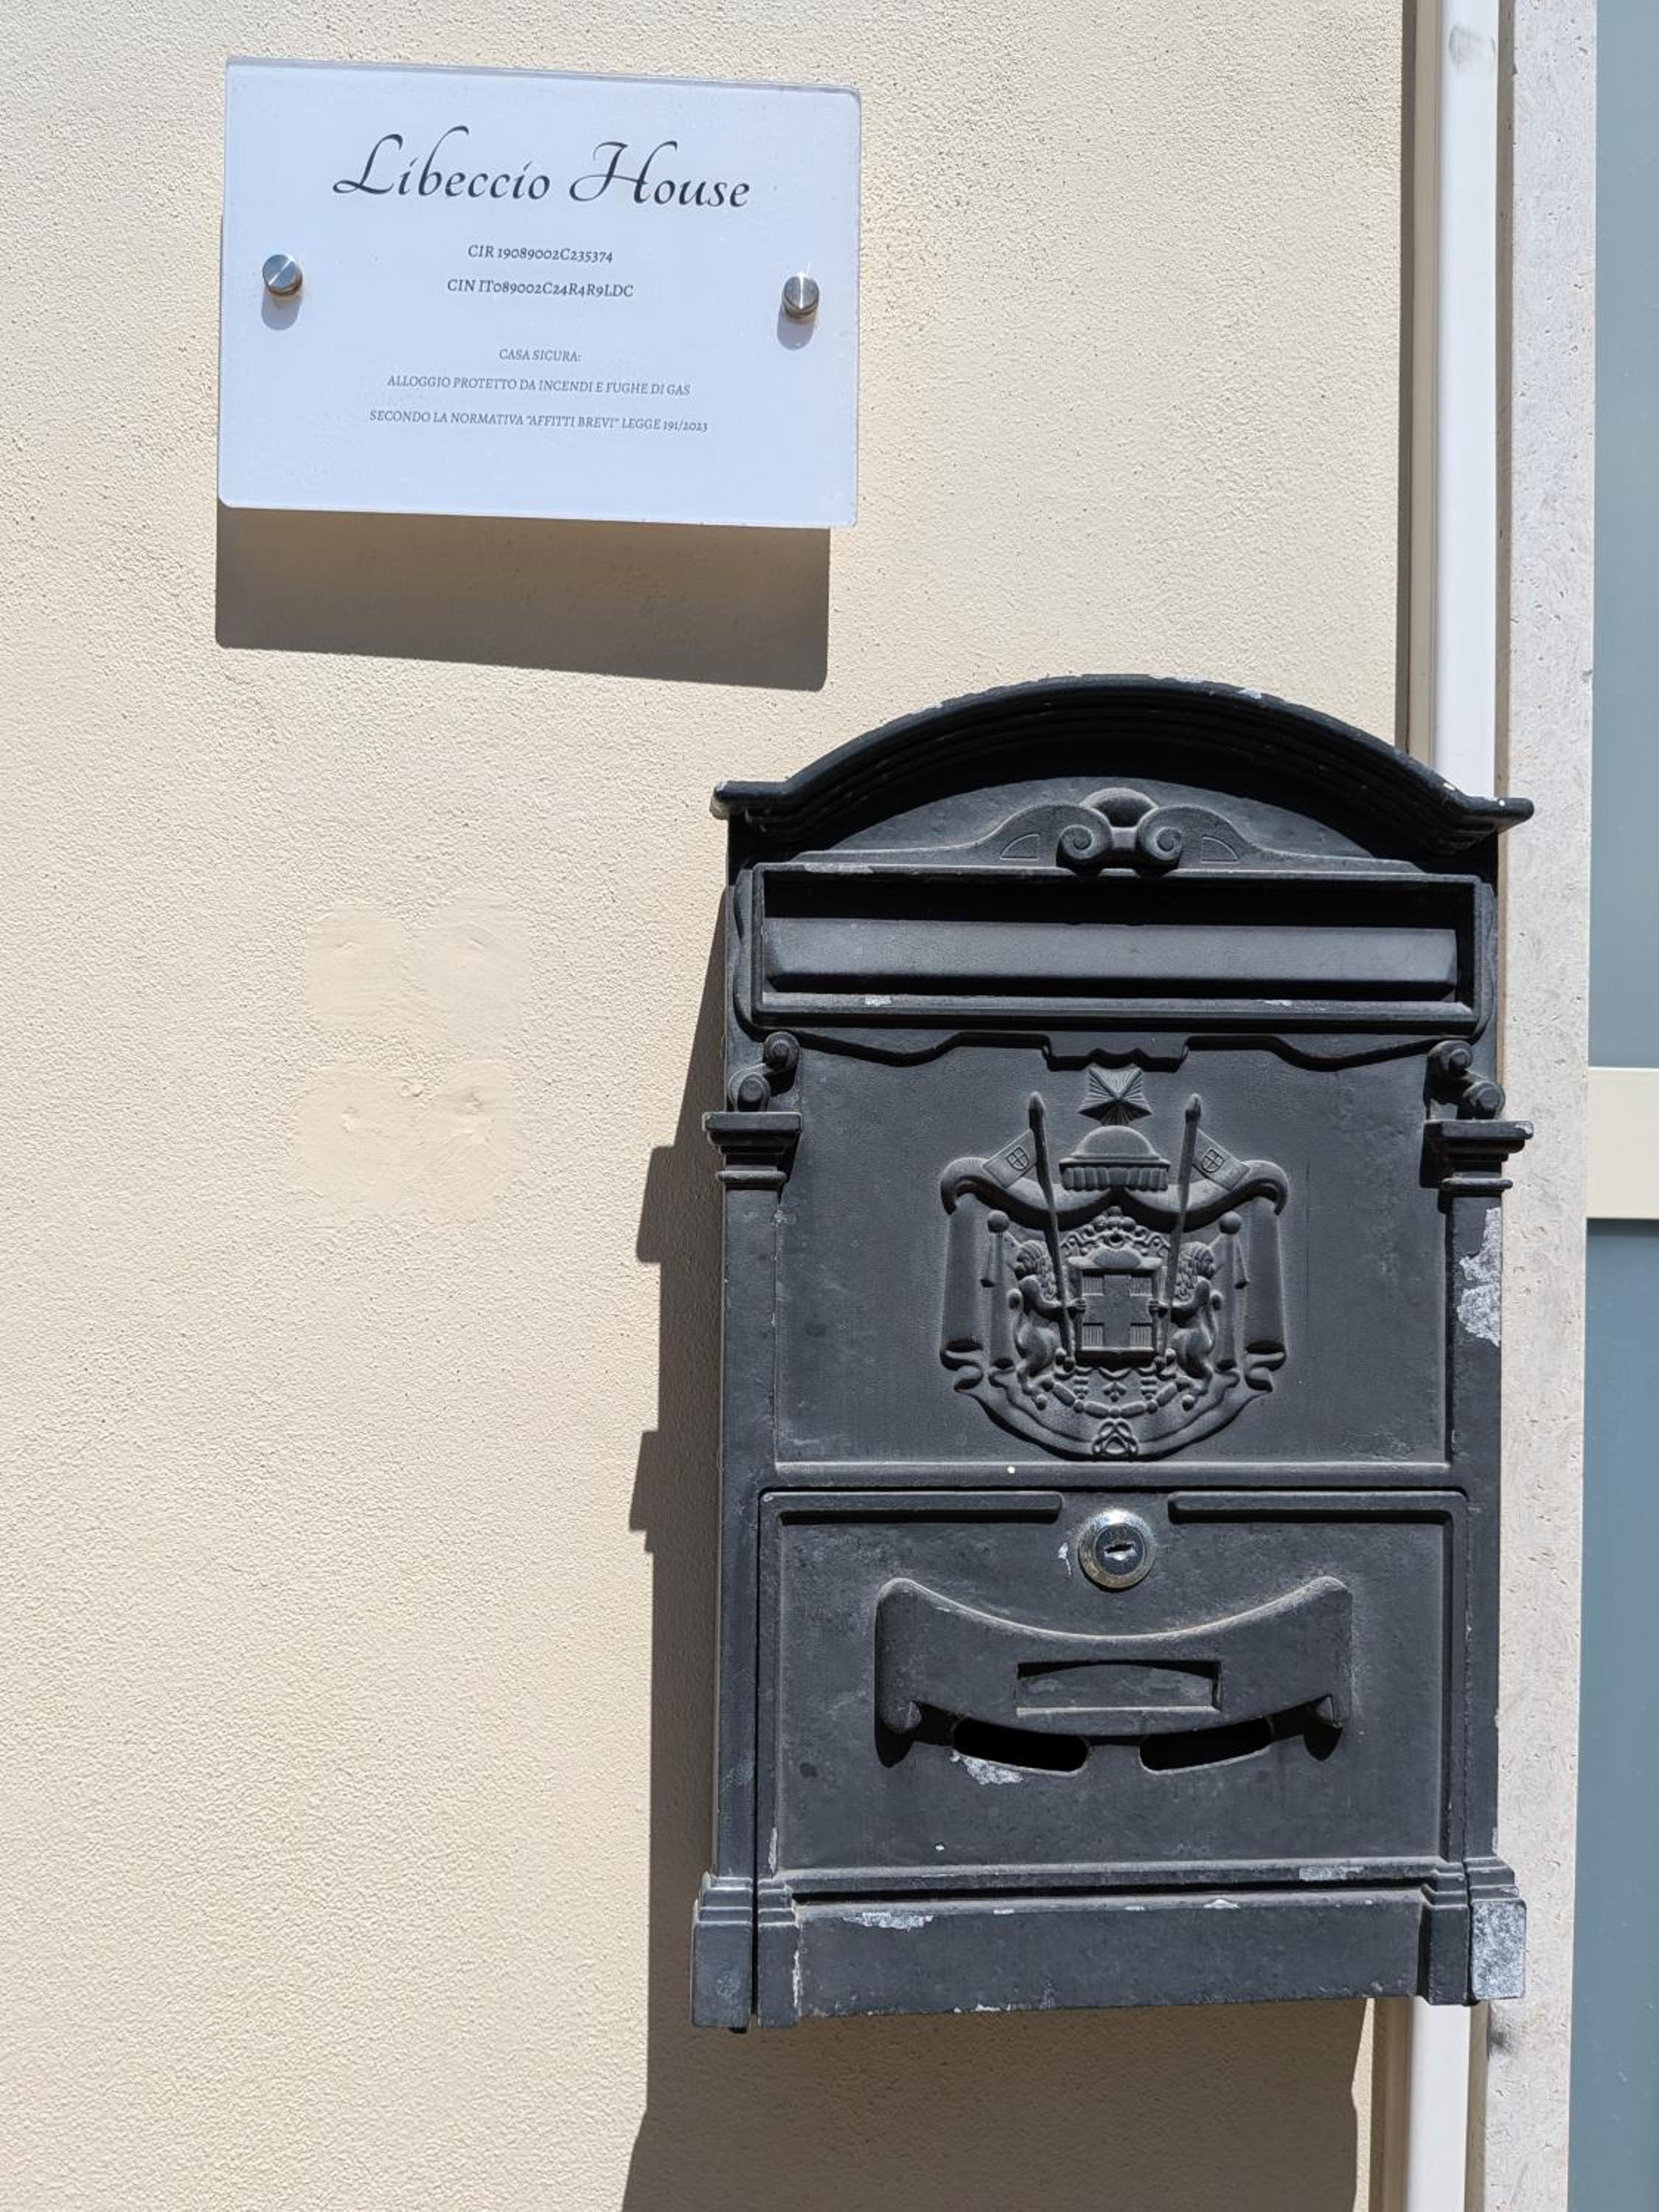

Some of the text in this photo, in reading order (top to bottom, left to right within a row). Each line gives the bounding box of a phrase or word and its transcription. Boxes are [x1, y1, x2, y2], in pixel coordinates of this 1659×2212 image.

[333, 125, 750, 207] Libeccio House
[467, 244, 613, 264] CIR 19089002C235374
[447, 278, 476, 292] CIN
[499, 349, 582, 362] CASA SICURA:
[387, 375, 691, 396] ALLOGGIO PROTETTO DA INCENDI E FUGHE DI GAS
[369, 410, 431, 422] SECONDO
[433, 412, 448, 423] LA
[451, 413, 524, 425] NORMATIVA
[622, 418, 661, 430] LEGGE
[663, 420, 709, 433] 191/2023
